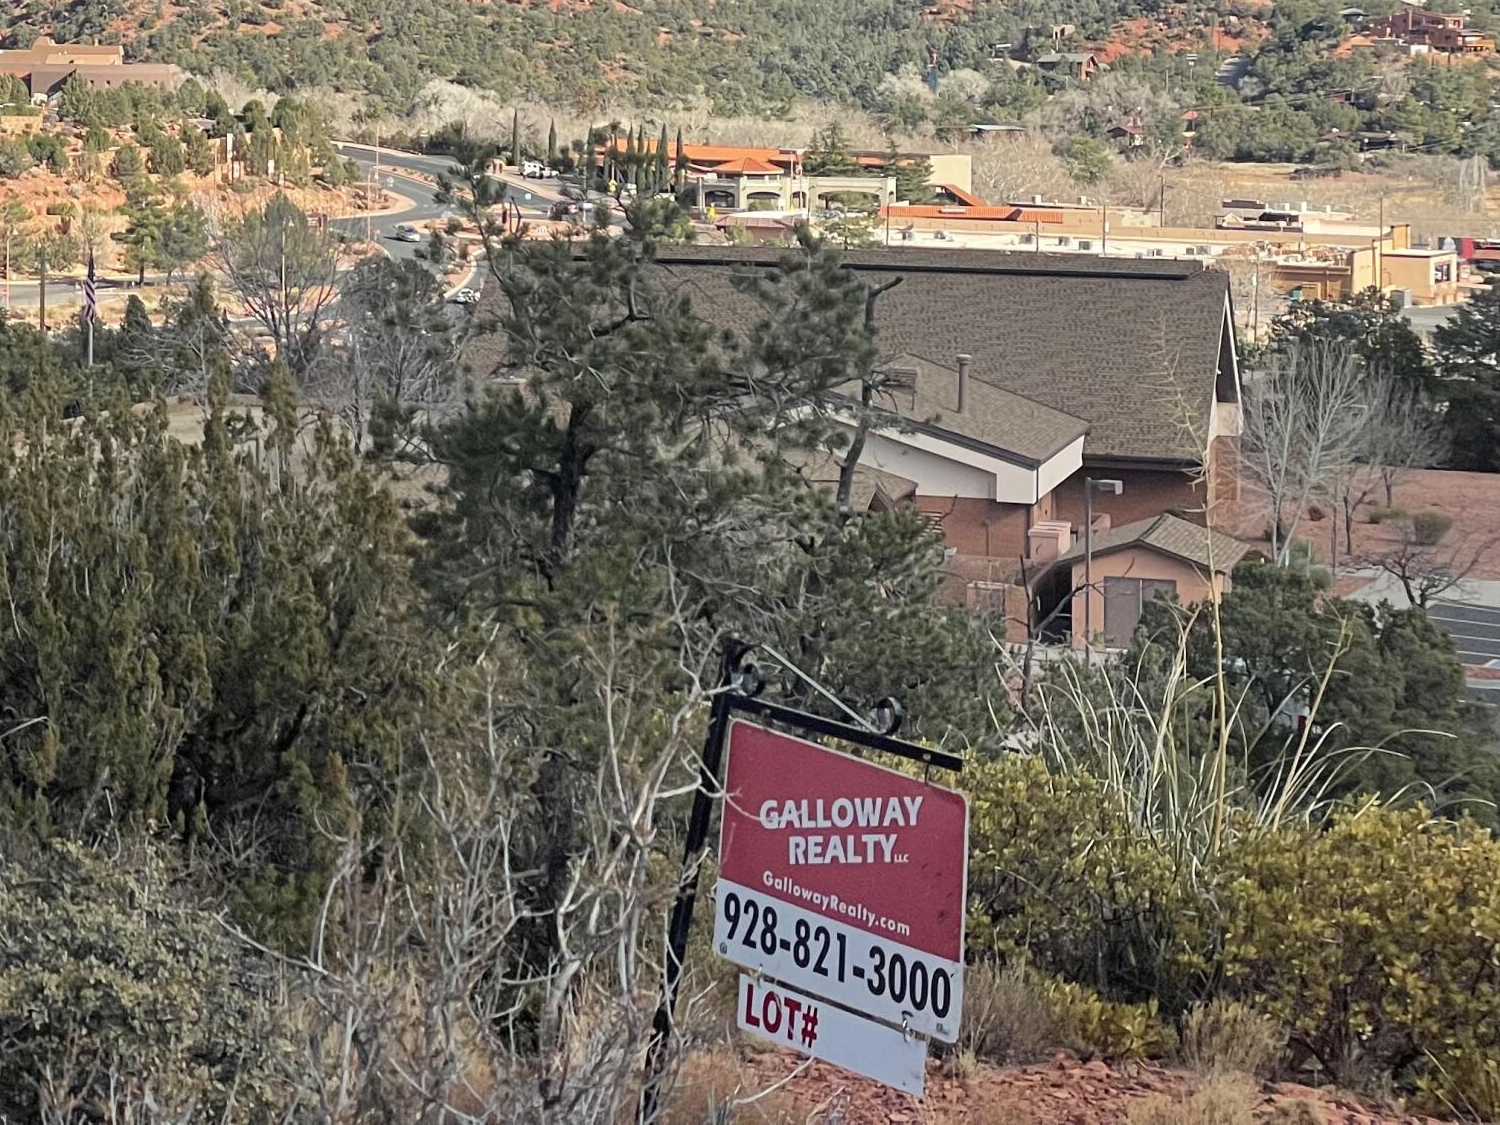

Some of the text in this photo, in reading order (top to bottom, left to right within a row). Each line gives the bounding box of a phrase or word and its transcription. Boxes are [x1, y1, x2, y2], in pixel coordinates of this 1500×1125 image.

[760, 796, 923, 829] GALLOWAY
[789, 834, 909, 864] REALTY LLC
[763, 871, 911, 936] GallowayRealty.com
[723, 891, 951, 1019] 928-821-3000
[745, 984, 819, 1048] LOT#
